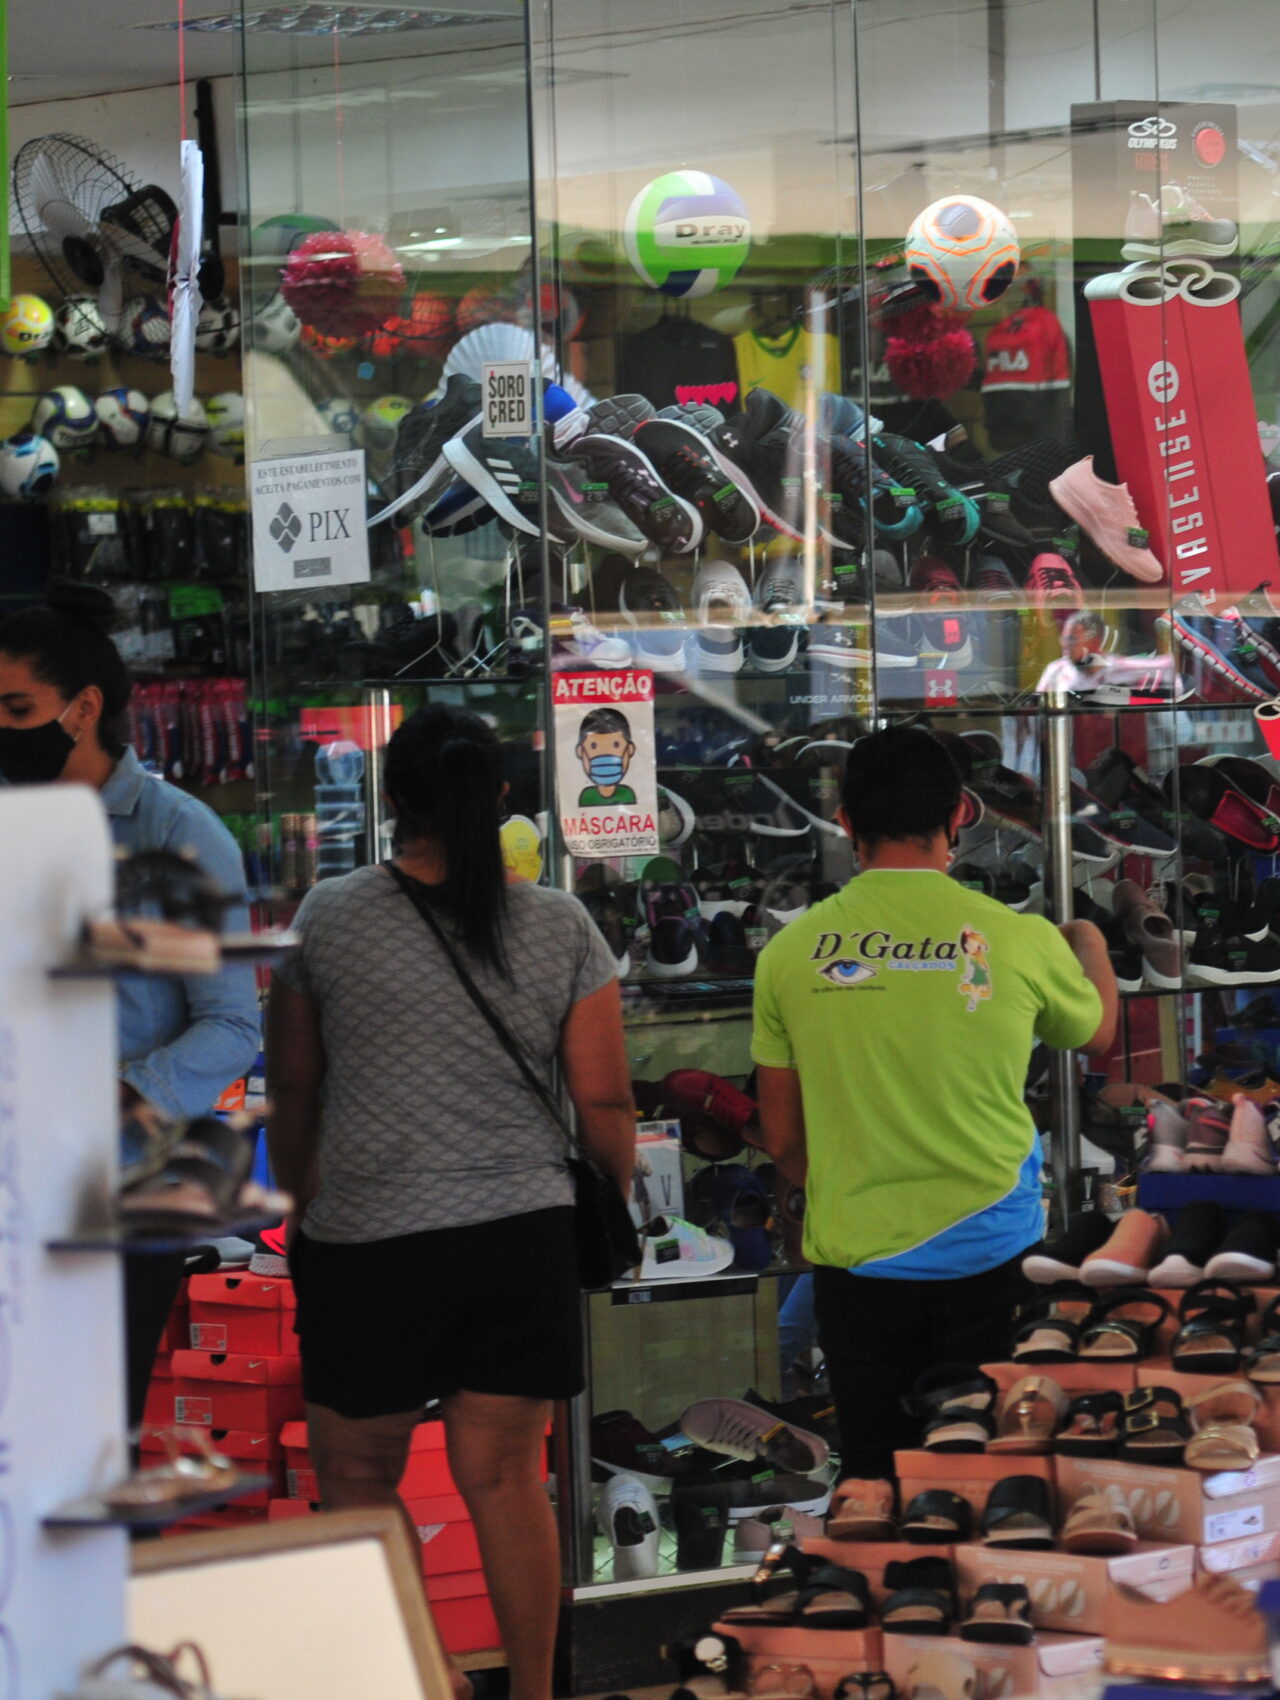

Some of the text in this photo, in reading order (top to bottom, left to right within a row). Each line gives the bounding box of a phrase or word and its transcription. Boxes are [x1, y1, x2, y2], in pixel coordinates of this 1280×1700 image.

[1127, 137, 1178, 149] OLYMPKUS
[675, 223, 746, 239] Dray
[988, 350, 1029, 373] FILA
[488, 372, 525, 398] SORO
[488, 399, 525, 426] CRED
[308, 508, 351, 542] PIX
[555, 672, 652, 699] ATENÇÃO
[789, 695, 828, 704] UNDER
[563, 812, 656, 837] MÁSCARA
[588, 835, 657, 850] OBRIGATÓRIO
[888, 961, 957, 972] CALÇADOS
